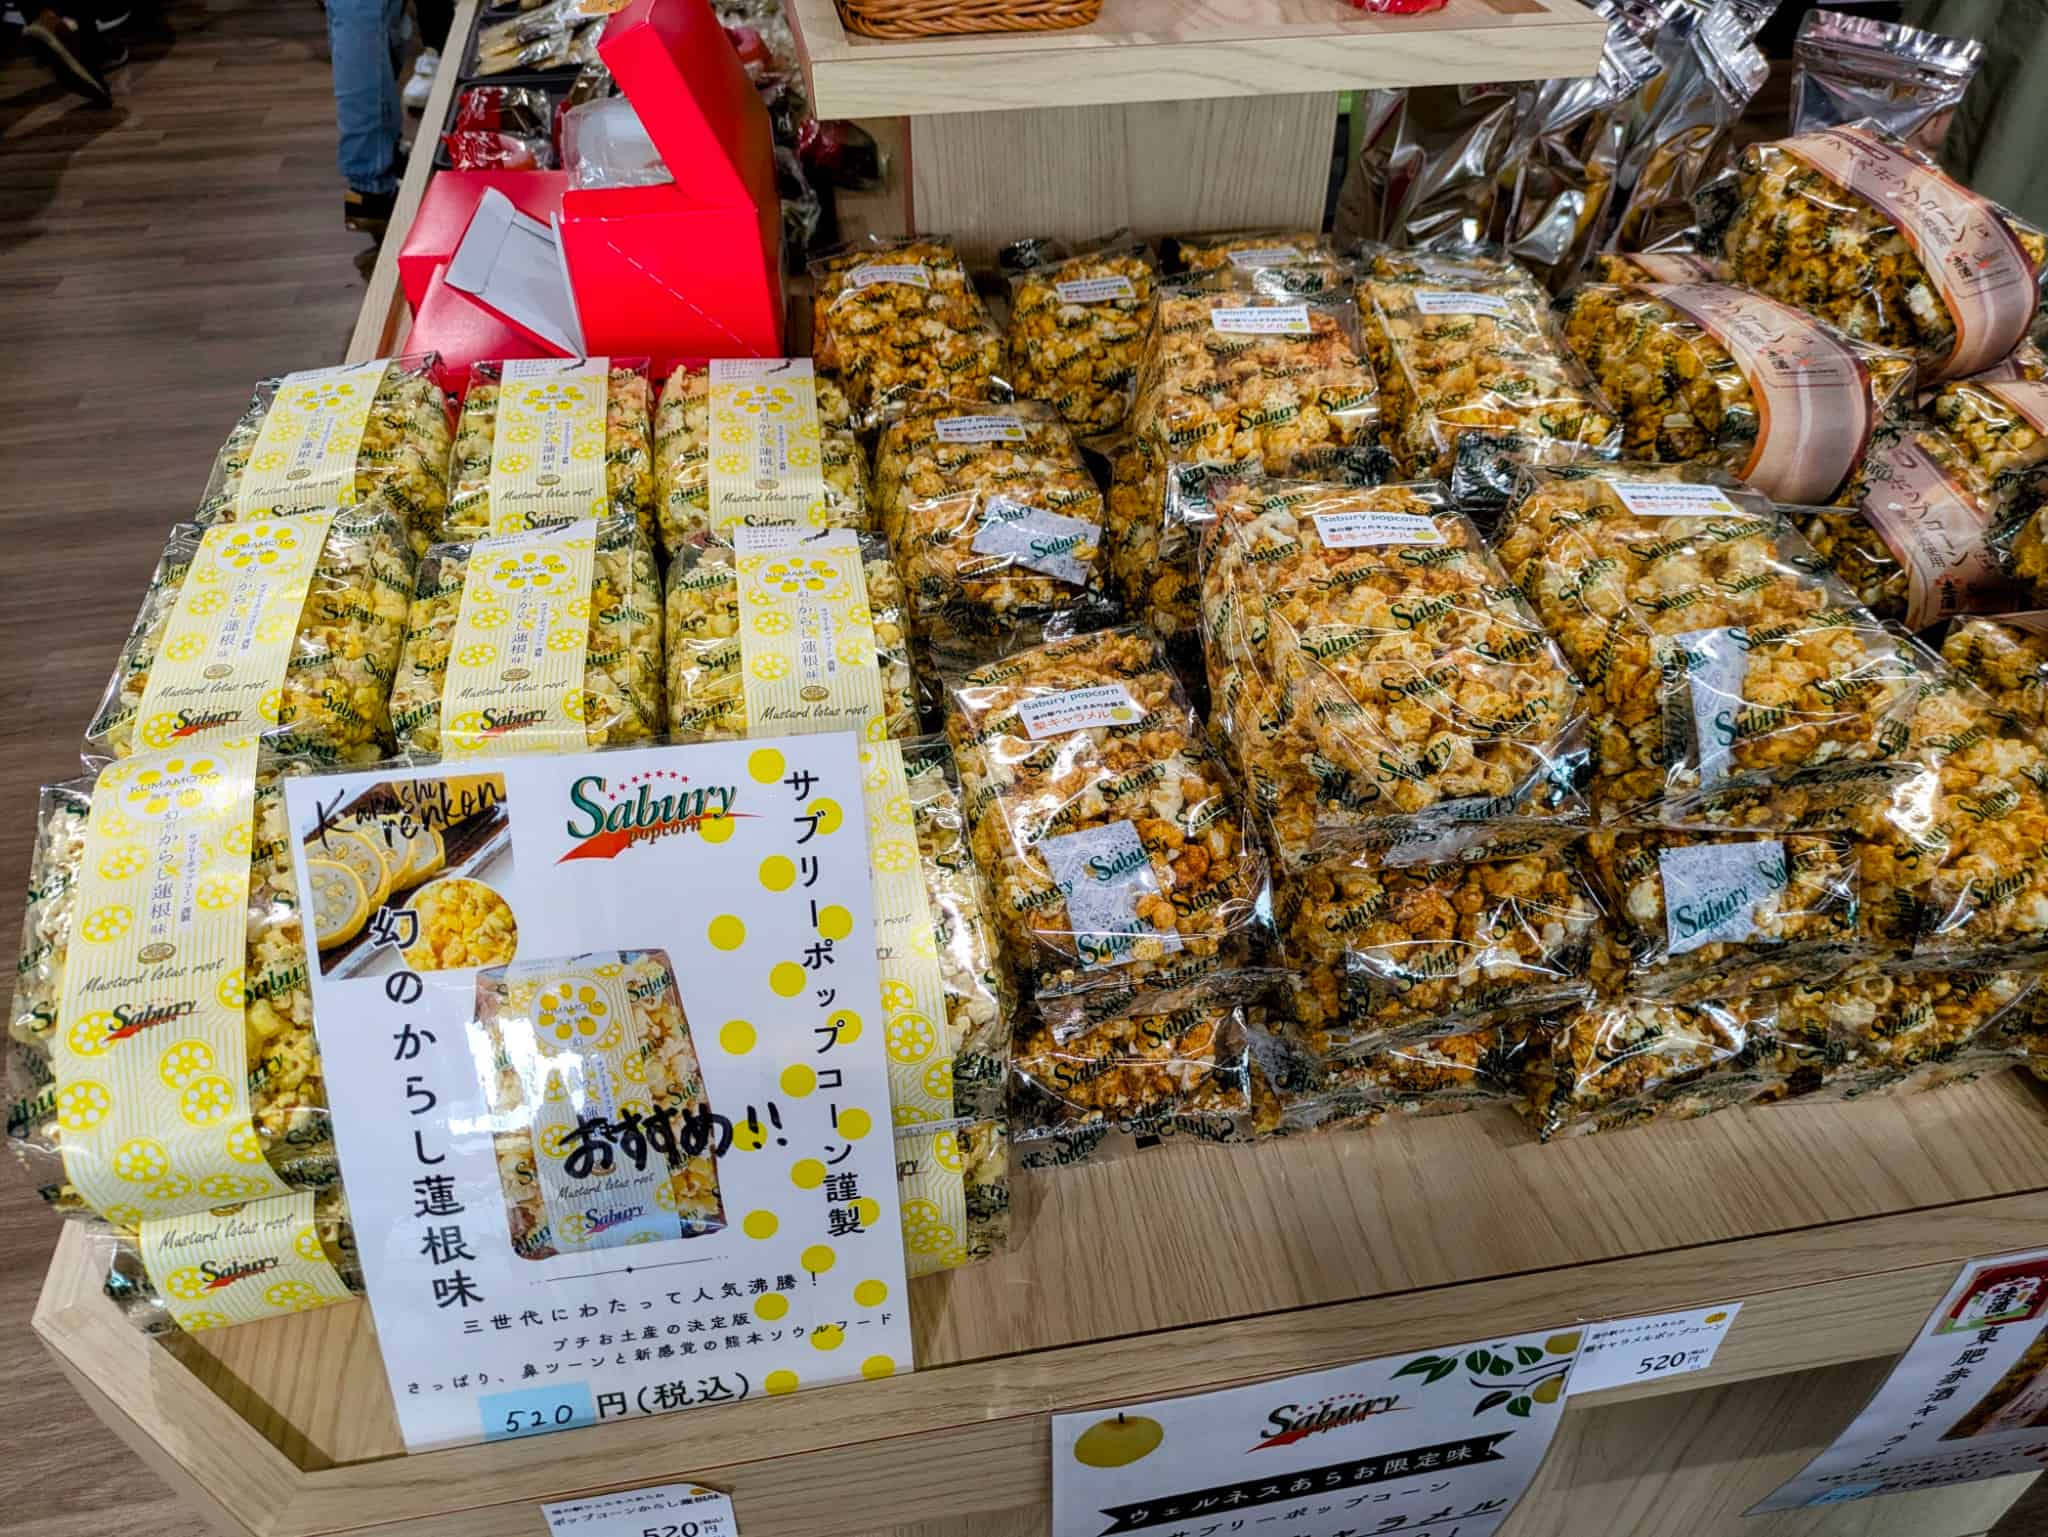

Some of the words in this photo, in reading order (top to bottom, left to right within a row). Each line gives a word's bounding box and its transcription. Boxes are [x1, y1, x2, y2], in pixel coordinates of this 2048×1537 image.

[1169, 420, 1218, 445] abury
[1320, 513, 1367, 524] Sabury
[1369, 514, 1425, 525] popcorn
[760, 705, 809, 721] Mustard
[813, 703, 841, 717] lotus
[845, 704, 869, 715] root
[1022, 694, 1067, 711] Sabury
[1070, 688, 1120, 702] popcorn
[174, 707, 243, 731] Sabury
[480, 707, 547, 731] Sabury
[1097, 762, 1167, 803] Sabury
[567, 776, 737, 840] Sabury
[626, 819, 703, 849] popcorn
[1677, 884, 1750, 939] Sabury
[79, 972, 145, 996] Mustard
[108, 999, 198, 1032] Sabury
[784, 769, 866, 1237] サブリーポップコーン謹製
[370, 906, 485, 1309] 幻のからし蓮根味
[584, 1202, 646, 1231] Sabury
[159, 1231, 221, 1251] Mustard
[225, 1223, 259, 1241] lotus
[264, 1213, 294, 1229] root
[200, 1255, 279, 1284] Sabury
[553, 1312, 751, 1352] プチお土産の決定版
[1636, 1351, 1686, 1375] 520
[506, 1404, 573, 1432] 520
[1261, 1394, 1400, 1439] Sabury
